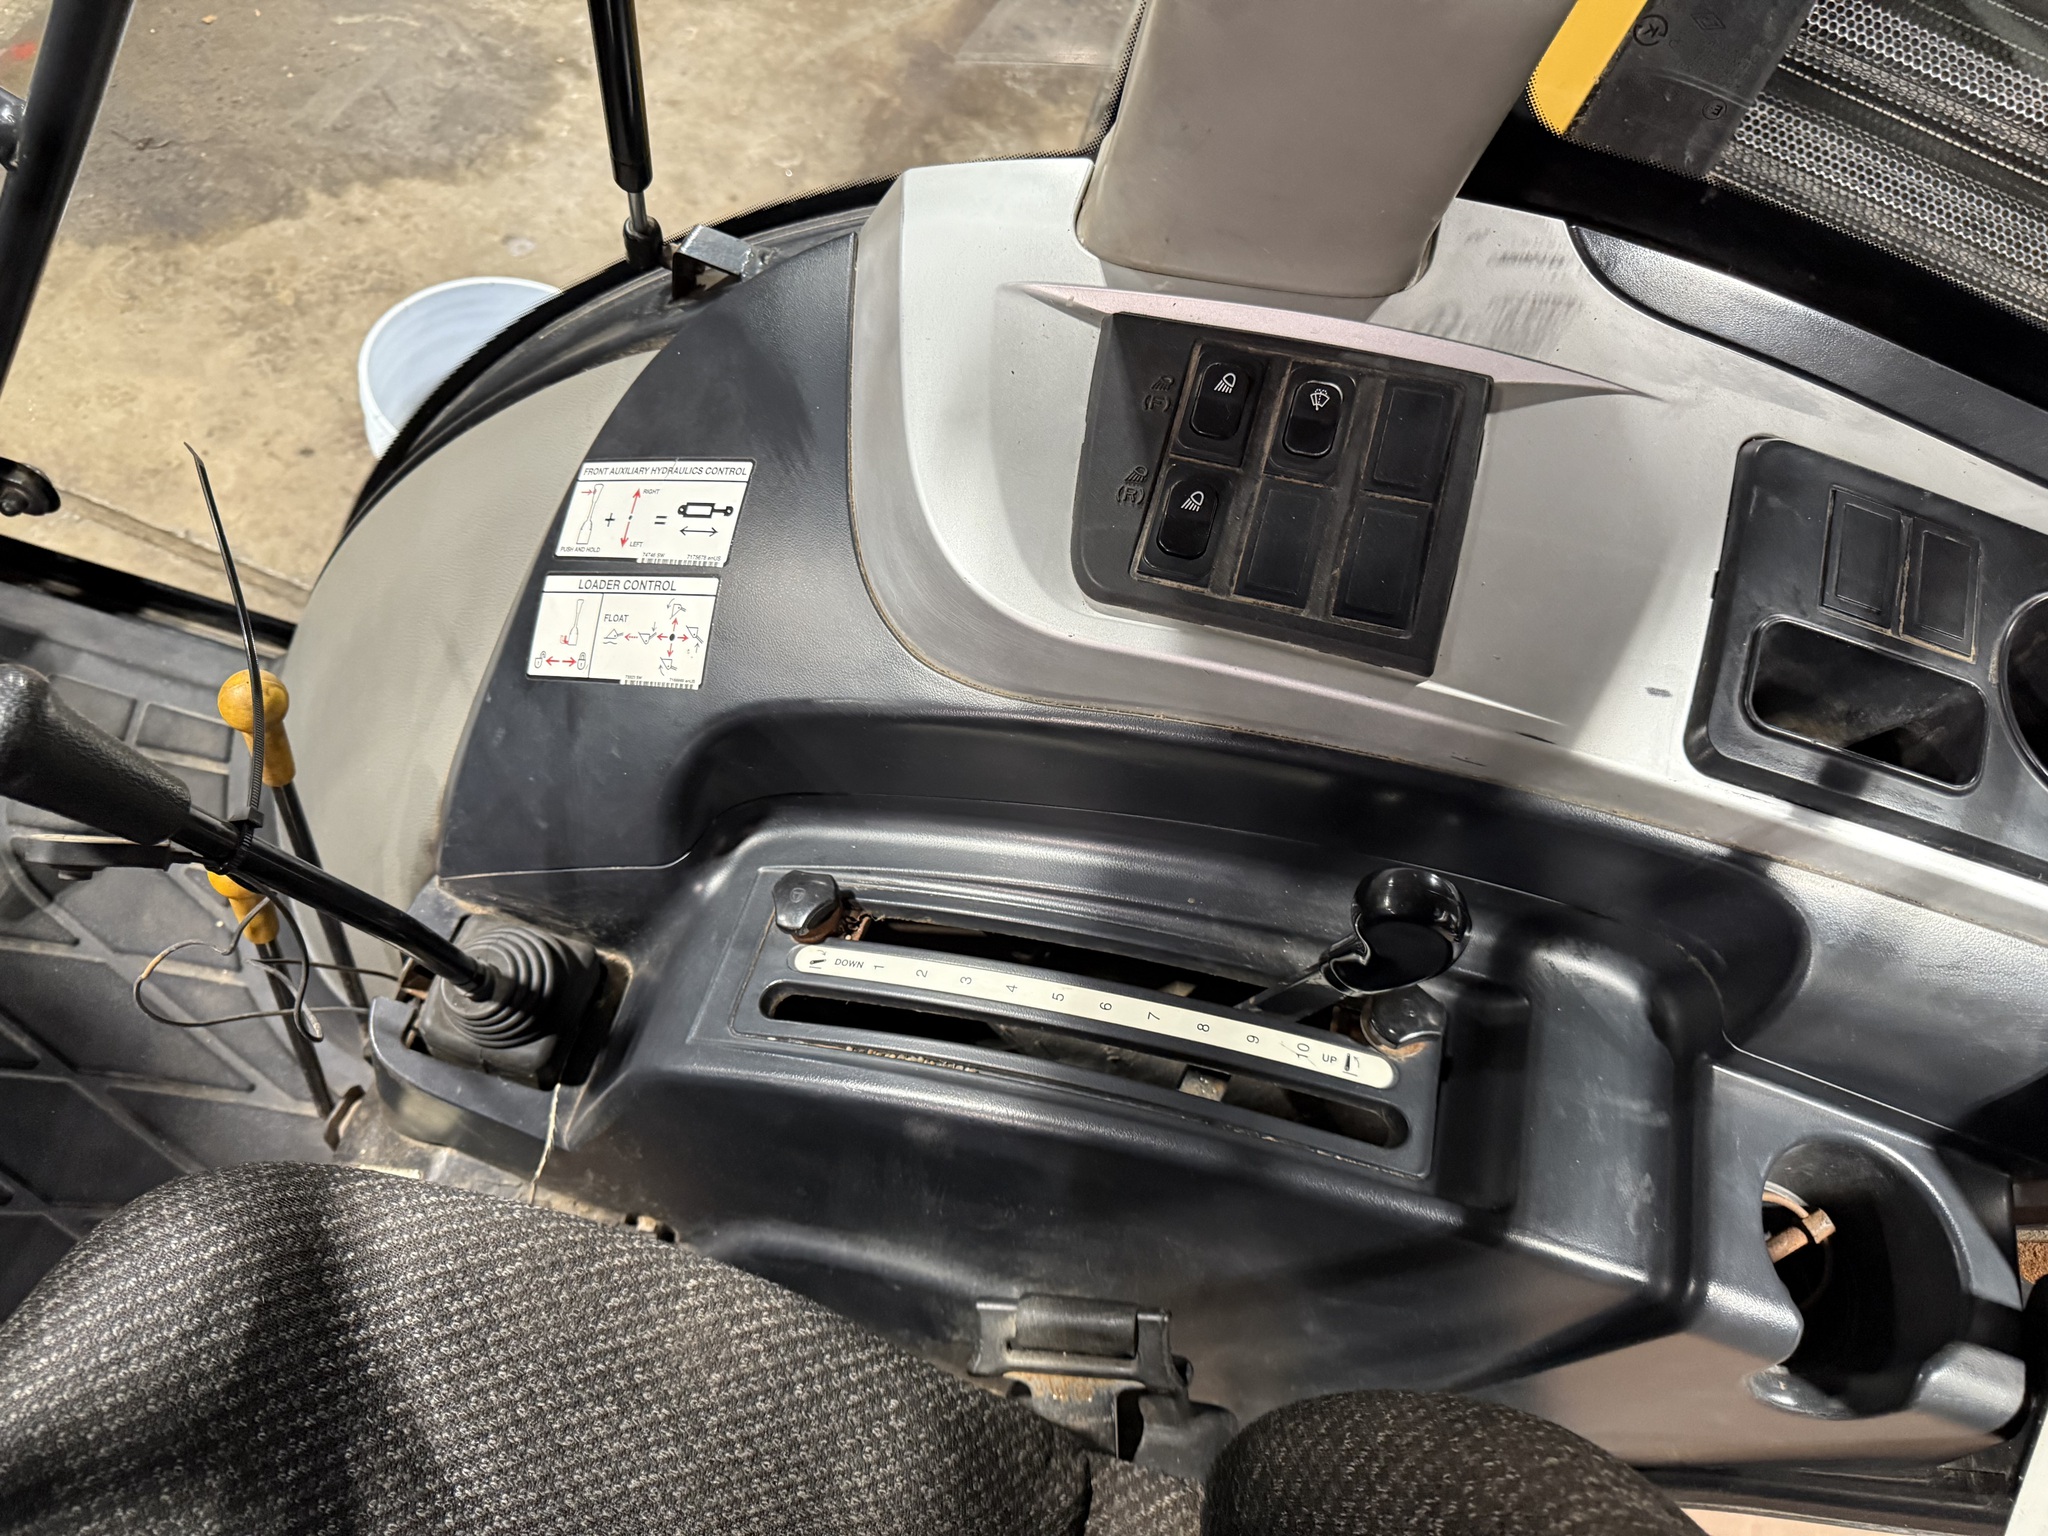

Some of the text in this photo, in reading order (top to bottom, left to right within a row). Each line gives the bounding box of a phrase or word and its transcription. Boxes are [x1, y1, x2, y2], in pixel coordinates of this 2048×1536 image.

[583, 466, 748, 476] FRONT AUXILIARY HYDRAULICS CONTROL
[578, 579, 677, 591] LOADER CONTROL
[603, 613, 629, 623] FLOAT
[834, 958, 865, 969] DOWN
[915, 968, 928, 978] 2
[959, 975, 973, 985] 3
[1005, 983, 1018, 993] 4
[1051, 991, 1065, 1002] 5
[1099, 1001, 1113, 1011] 6
[1147, 1011, 1161, 1022] 7
[1196, 1022, 1210, 1033] 8
[1246, 1034, 1260, 1044] 9
[1296, 1042, 1310, 1059] 10
[1322, 1053, 1338, 1064] UP
